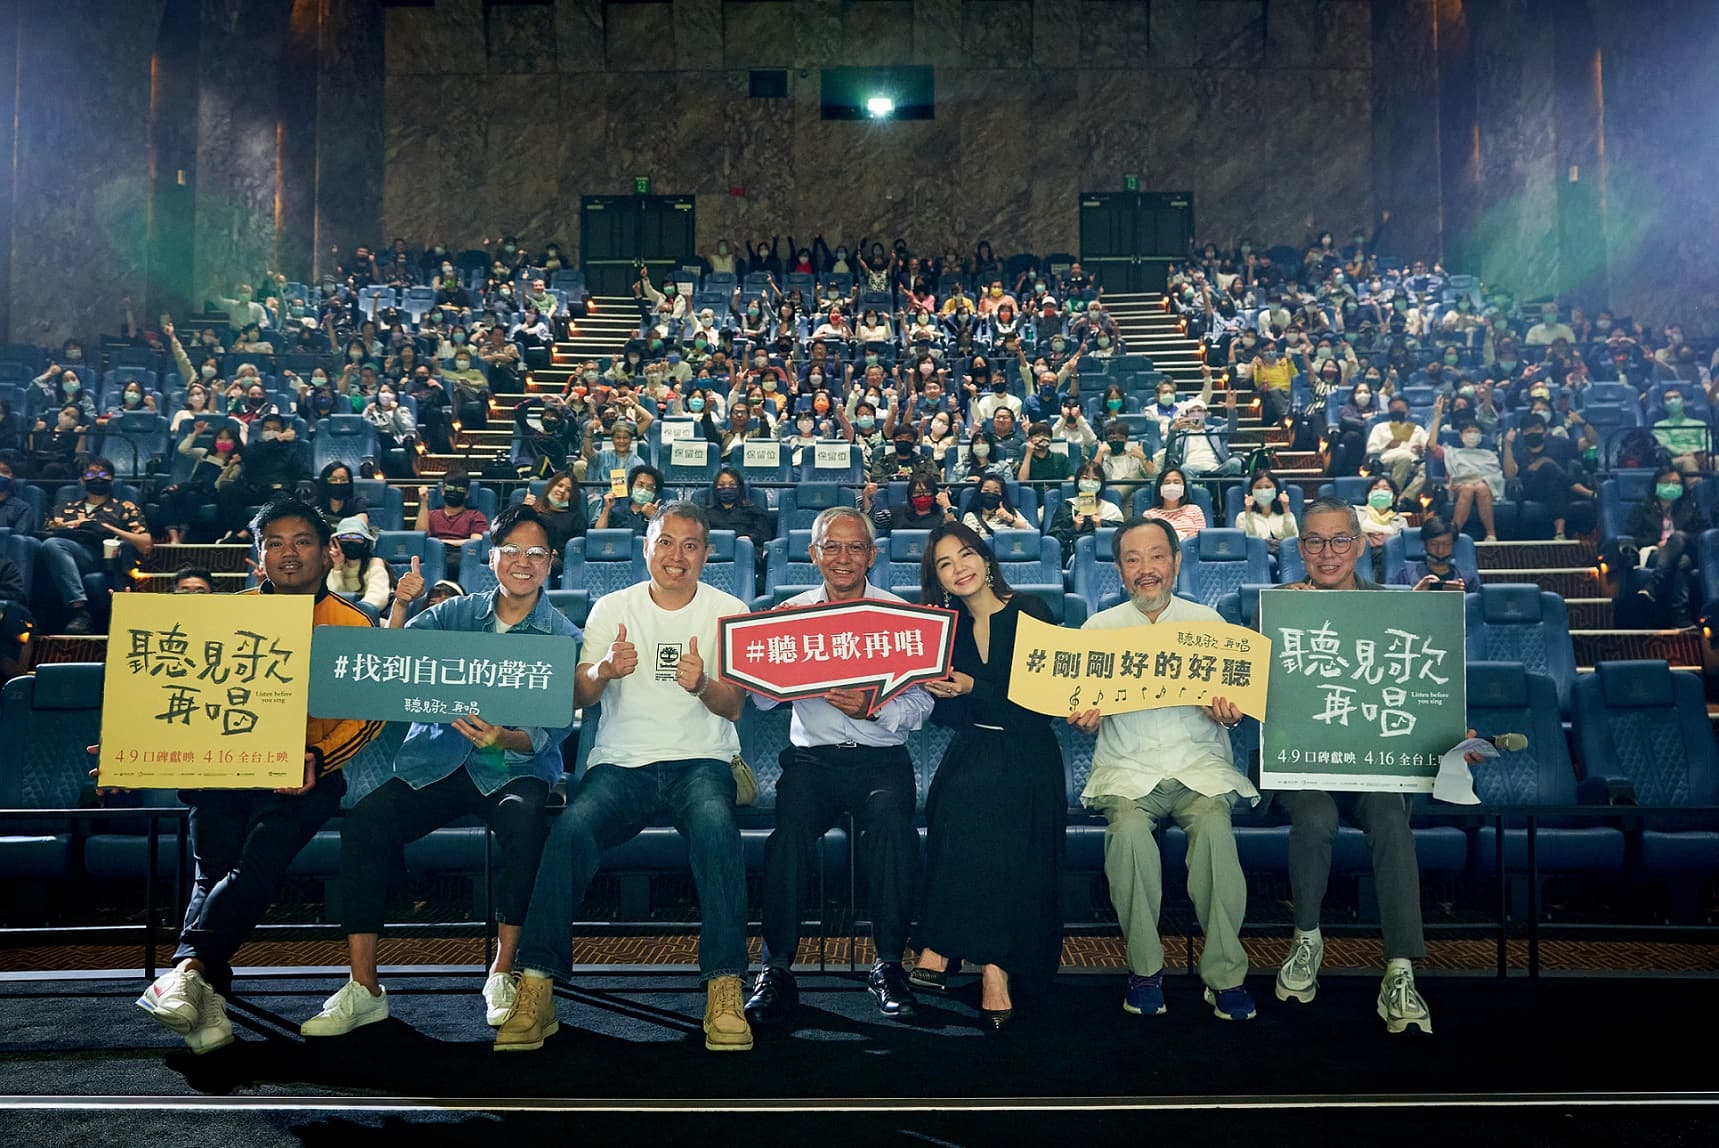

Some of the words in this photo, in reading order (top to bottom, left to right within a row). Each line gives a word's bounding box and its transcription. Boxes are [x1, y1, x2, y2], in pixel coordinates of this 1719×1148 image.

[674, 448, 705, 459] 保留位
[746, 448, 776, 460] 保留位
[817, 451, 847, 462] 保留位
[126, 621, 294, 684] 聽見歌
[746, 628, 924, 665] #聽見歌再唱
[1278, 619, 1449, 686] 聽見歌
[334, 653, 553, 690] #找到自己的聲音
[1026, 648, 1252, 688] #剛剛好的好聽
[155, 685, 259, 736] 再唱
[1312, 684, 1417, 737] 再唱
[1430, 698, 1442, 706] sing
[239, 751, 289, 763] 全台上映
